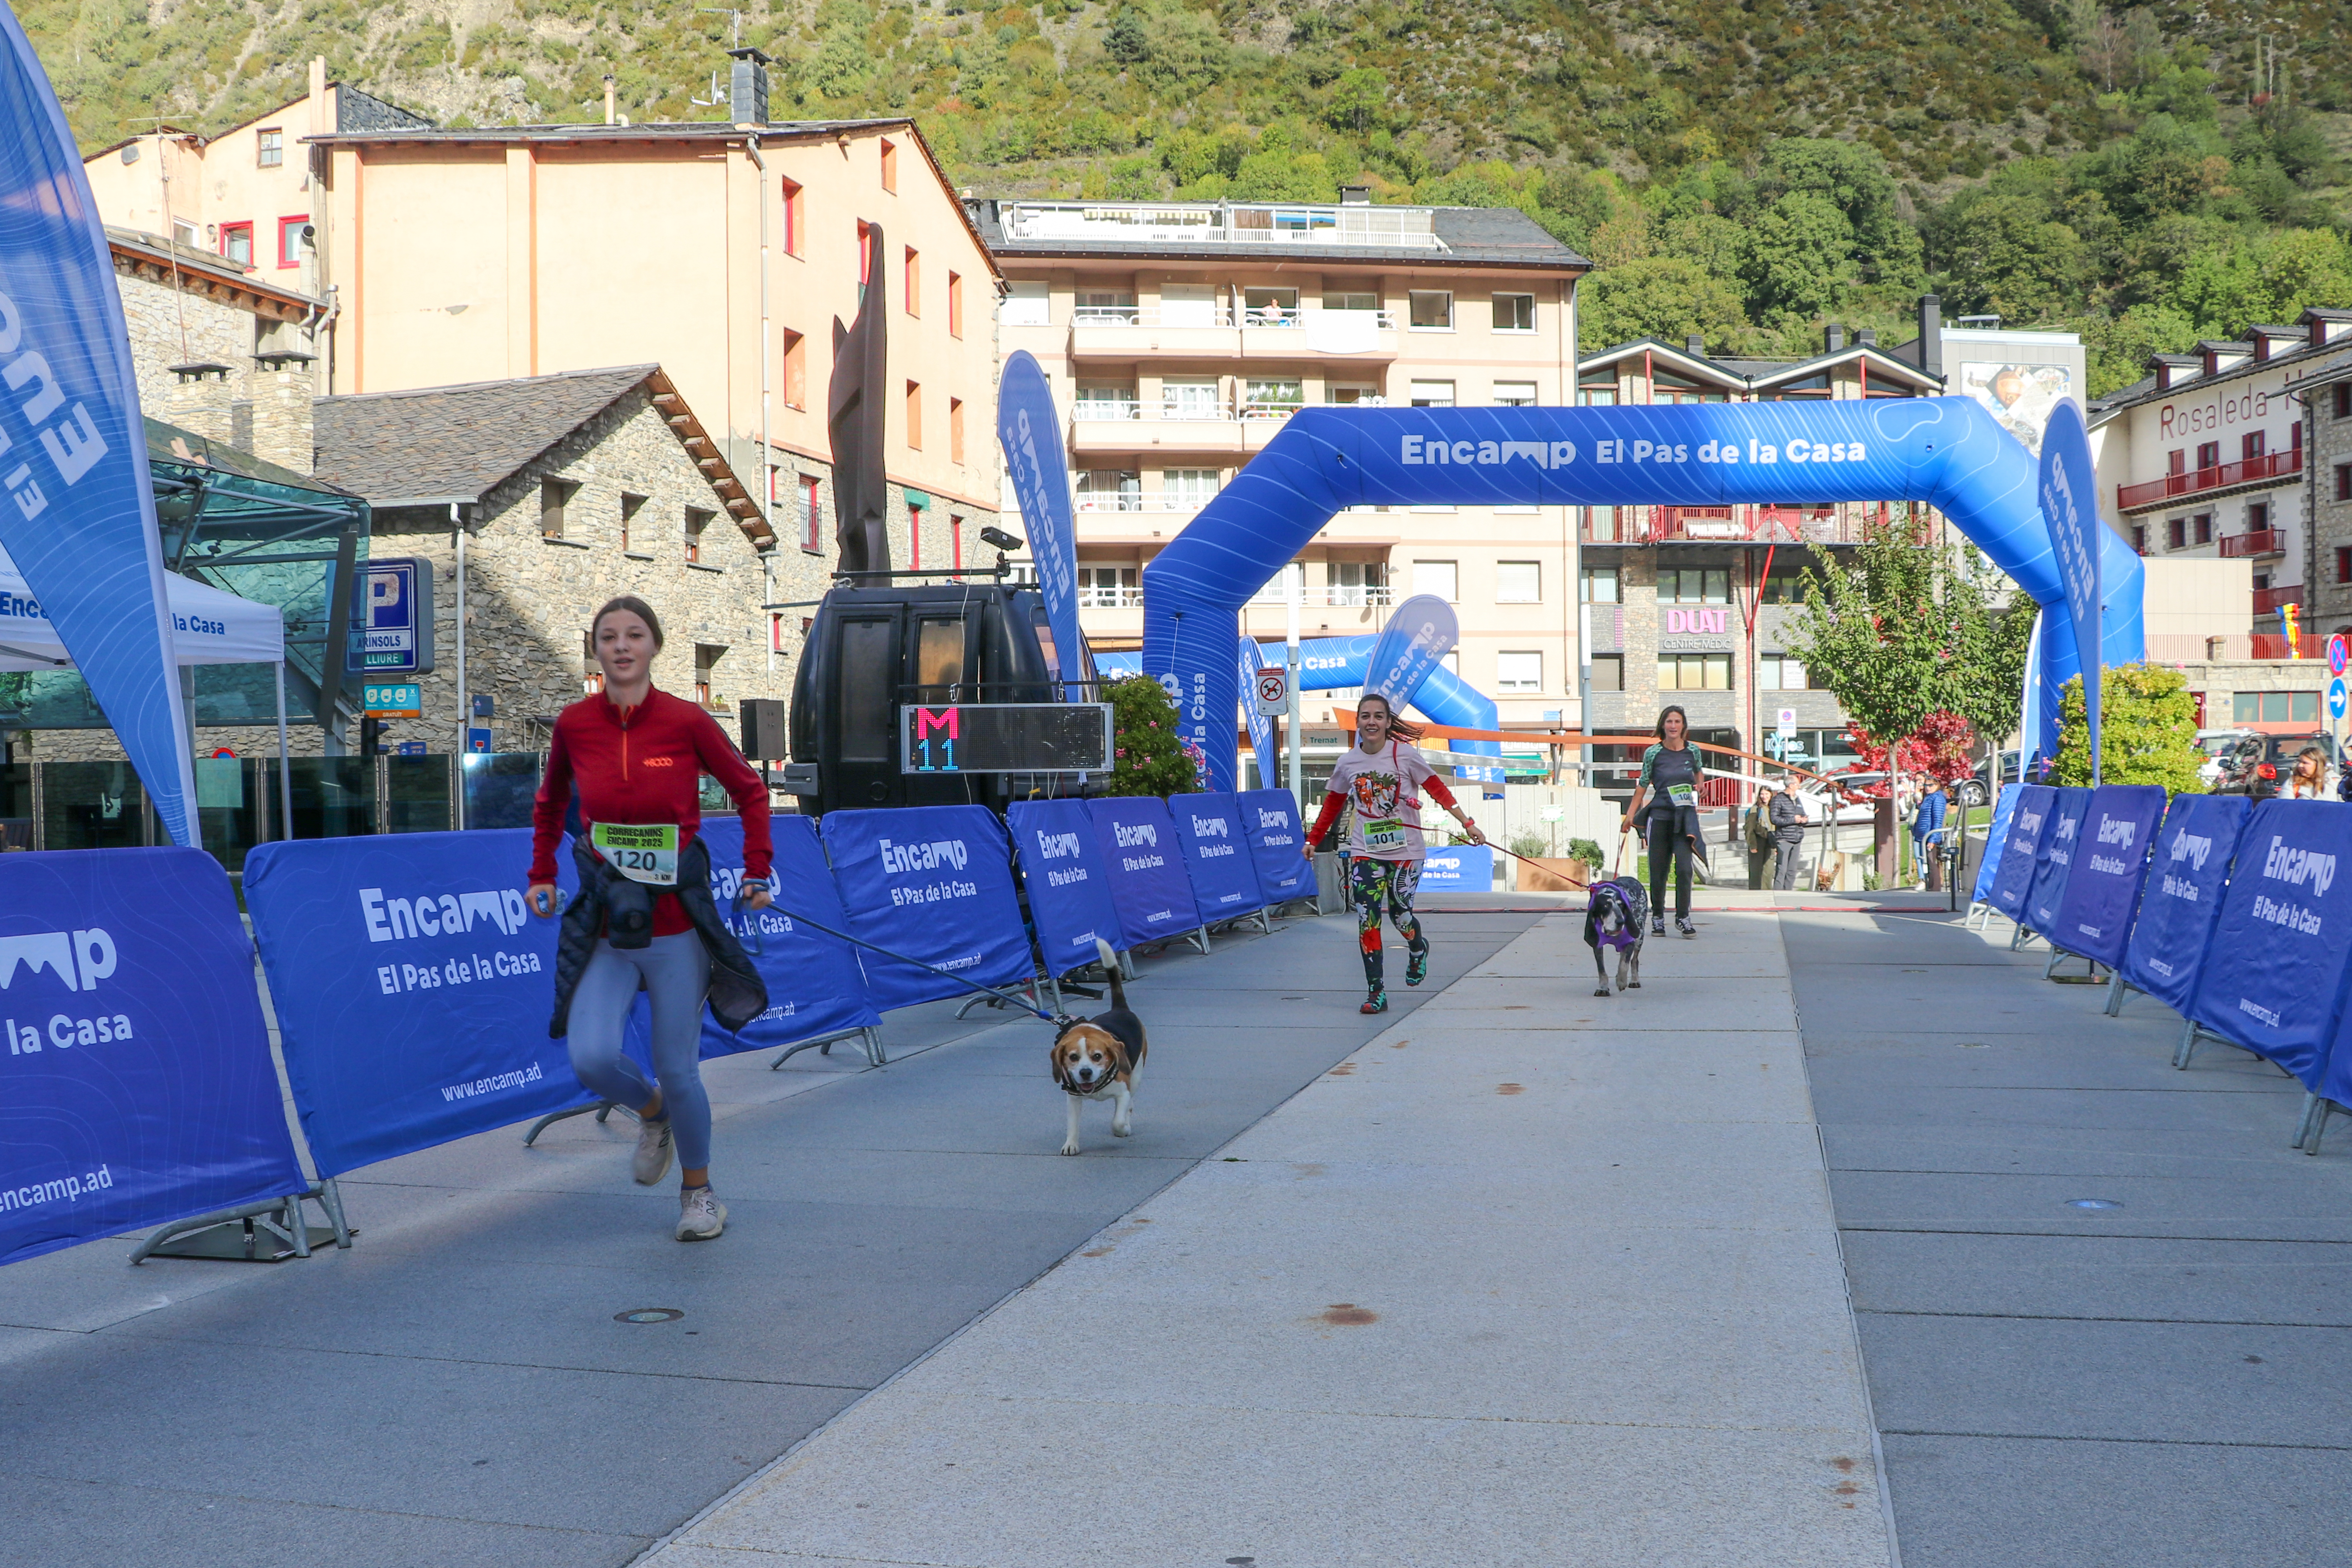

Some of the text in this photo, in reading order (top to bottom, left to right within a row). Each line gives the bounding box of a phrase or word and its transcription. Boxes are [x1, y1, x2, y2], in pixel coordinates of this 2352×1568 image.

[2161, 383, 2267, 441] Rosaleda
[1401, 434, 1866, 469] Encamp El Pas de la Casa
[360, 573, 400, 628] P
[172, 613, 225, 635] la Casa
[1664, 639, 1698, 649] CENTRE
[366, 653, 399, 664] LLIURE
[1305, 657, 1346, 670] Casa
[1391, 635, 1448, 705] Pas de la Casa
[1191, 673, 1206, 720] Casa
[917, 707, 959, 740] M
[1191, 725, 1206, 743] la
[607, 826, 664, 837] CORRECANINS
[1191, 815, 1228, 838] Encamp
[1258, 808, 1289, 829] Encamp
[2097, 813, 2136, 850] Encamp
[607, 836, 663, 847] ENCAMP 2025
[1037, 830, 1081, 859] Encamp
[1112, 821, 1157, 848] Encamp
[1373, 832, 1395, 845] 101
[614, 850, 657, 871] 120
[879, 838, 968, 874] Encamp
[1129, 858, 1140, 871] Pas
[1139, 856, 1147, 869] de
[1144, 855, 1152, 868] la
[1150, 854, 1164, 867] Casa
[1222, 844, 1235, 855] Casa
[1053, 871, 1064, 886] Pas
[1064, 869, 1071, 884] de
[1069, 868, 1076, 883] la
[1075, 867, 1088, 881] Casa
[2263, 835, 2336, 898] Encamp
[890, 880, 977, 906] El Pas de la Casa
[359, 888, 527, 943] Encamp
[759, 913, 794, 935] Casa
[2252, 895, 2321, 936] El Pas de la Casa
[377, 951, 542, 995] El Pas de la Casa
[7, 1013, 133, 1056] la Casa
[441, 1062, 543, 1102] www.encamp.ad
